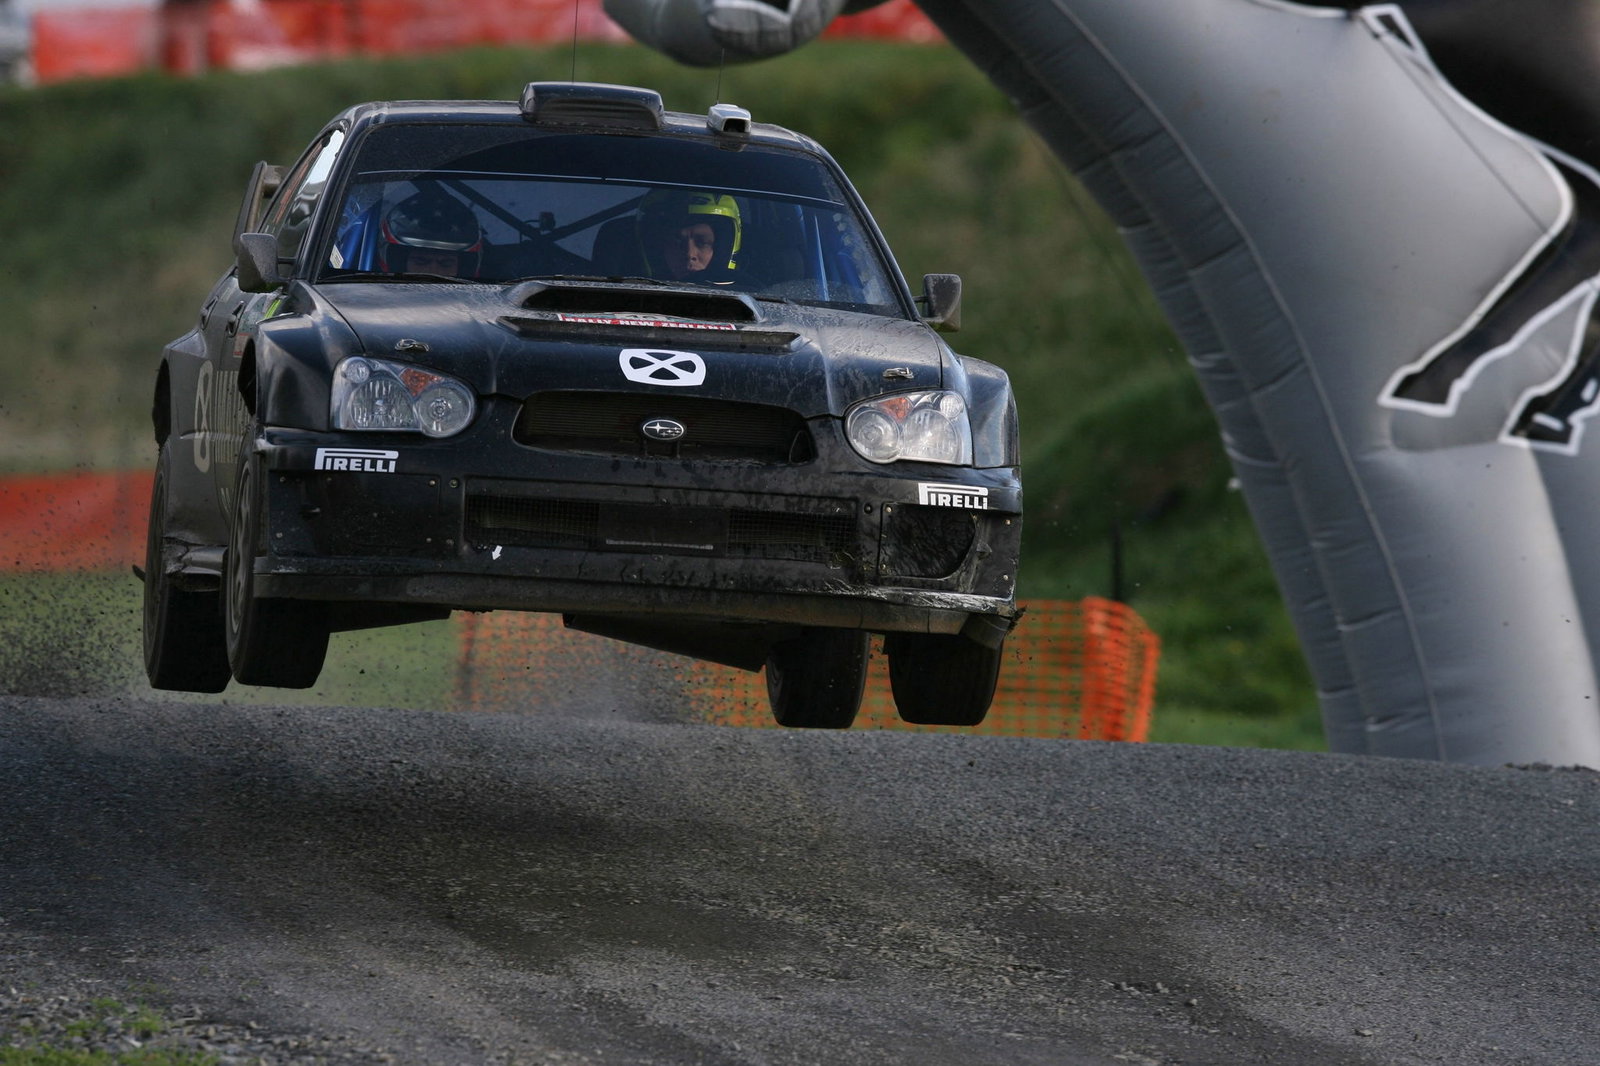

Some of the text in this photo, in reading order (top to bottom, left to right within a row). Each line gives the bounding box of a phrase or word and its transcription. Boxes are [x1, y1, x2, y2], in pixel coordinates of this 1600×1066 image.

[565, 317, 612, 325] RALLY
[619, 319, 655, 327] NEW
[314, 447, 399, 473] PIRELLI
[918, 482, 988, 510] PIRELLI
